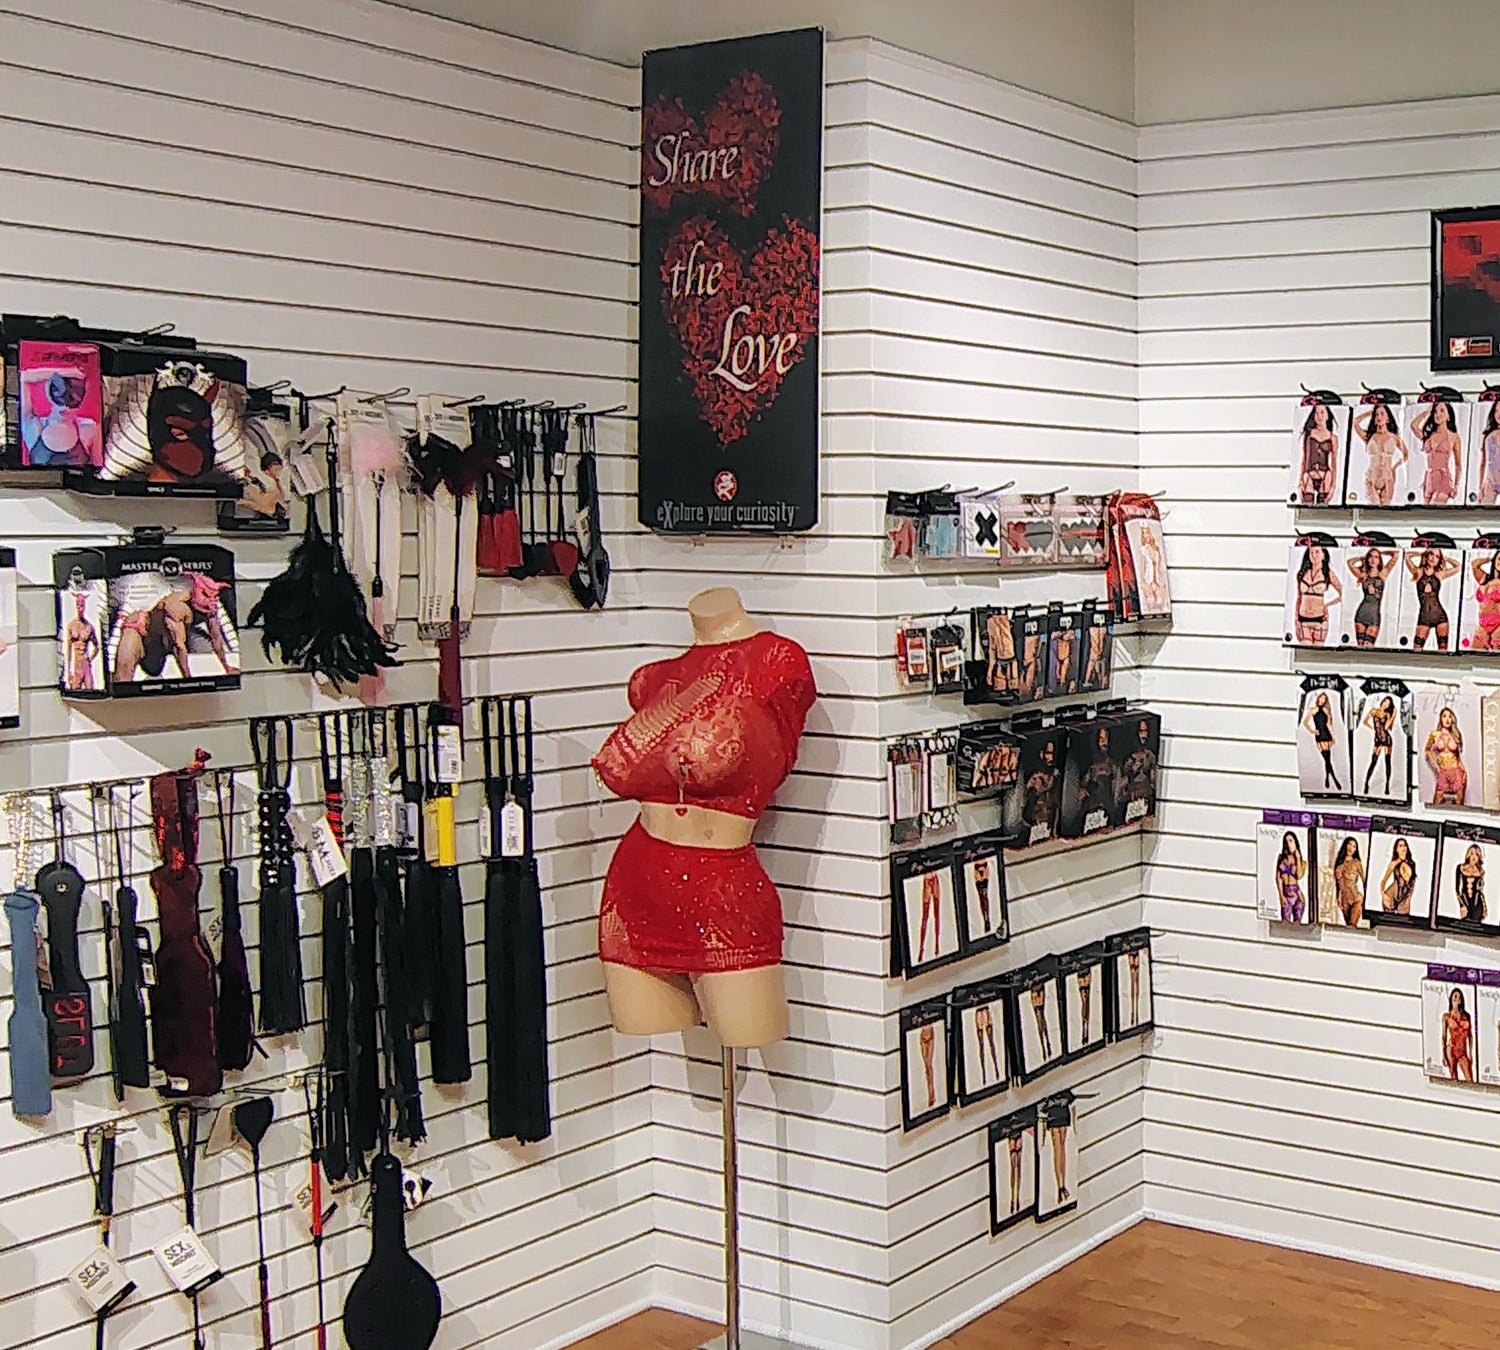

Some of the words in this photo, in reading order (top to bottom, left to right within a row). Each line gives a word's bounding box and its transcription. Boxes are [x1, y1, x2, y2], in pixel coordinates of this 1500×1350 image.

[649, 131, 739, 190] Share
[669, 240, 724, 299] the
[710, 304, 798, 392] Love
[656, 500, 704, 529] eXplore
[706, 505, 734, 526] your
[121, 561, 160, 571] MASTER
[163, 1240, 188, 1260] SEX
[77, 1260, 102, 1283] SEX
